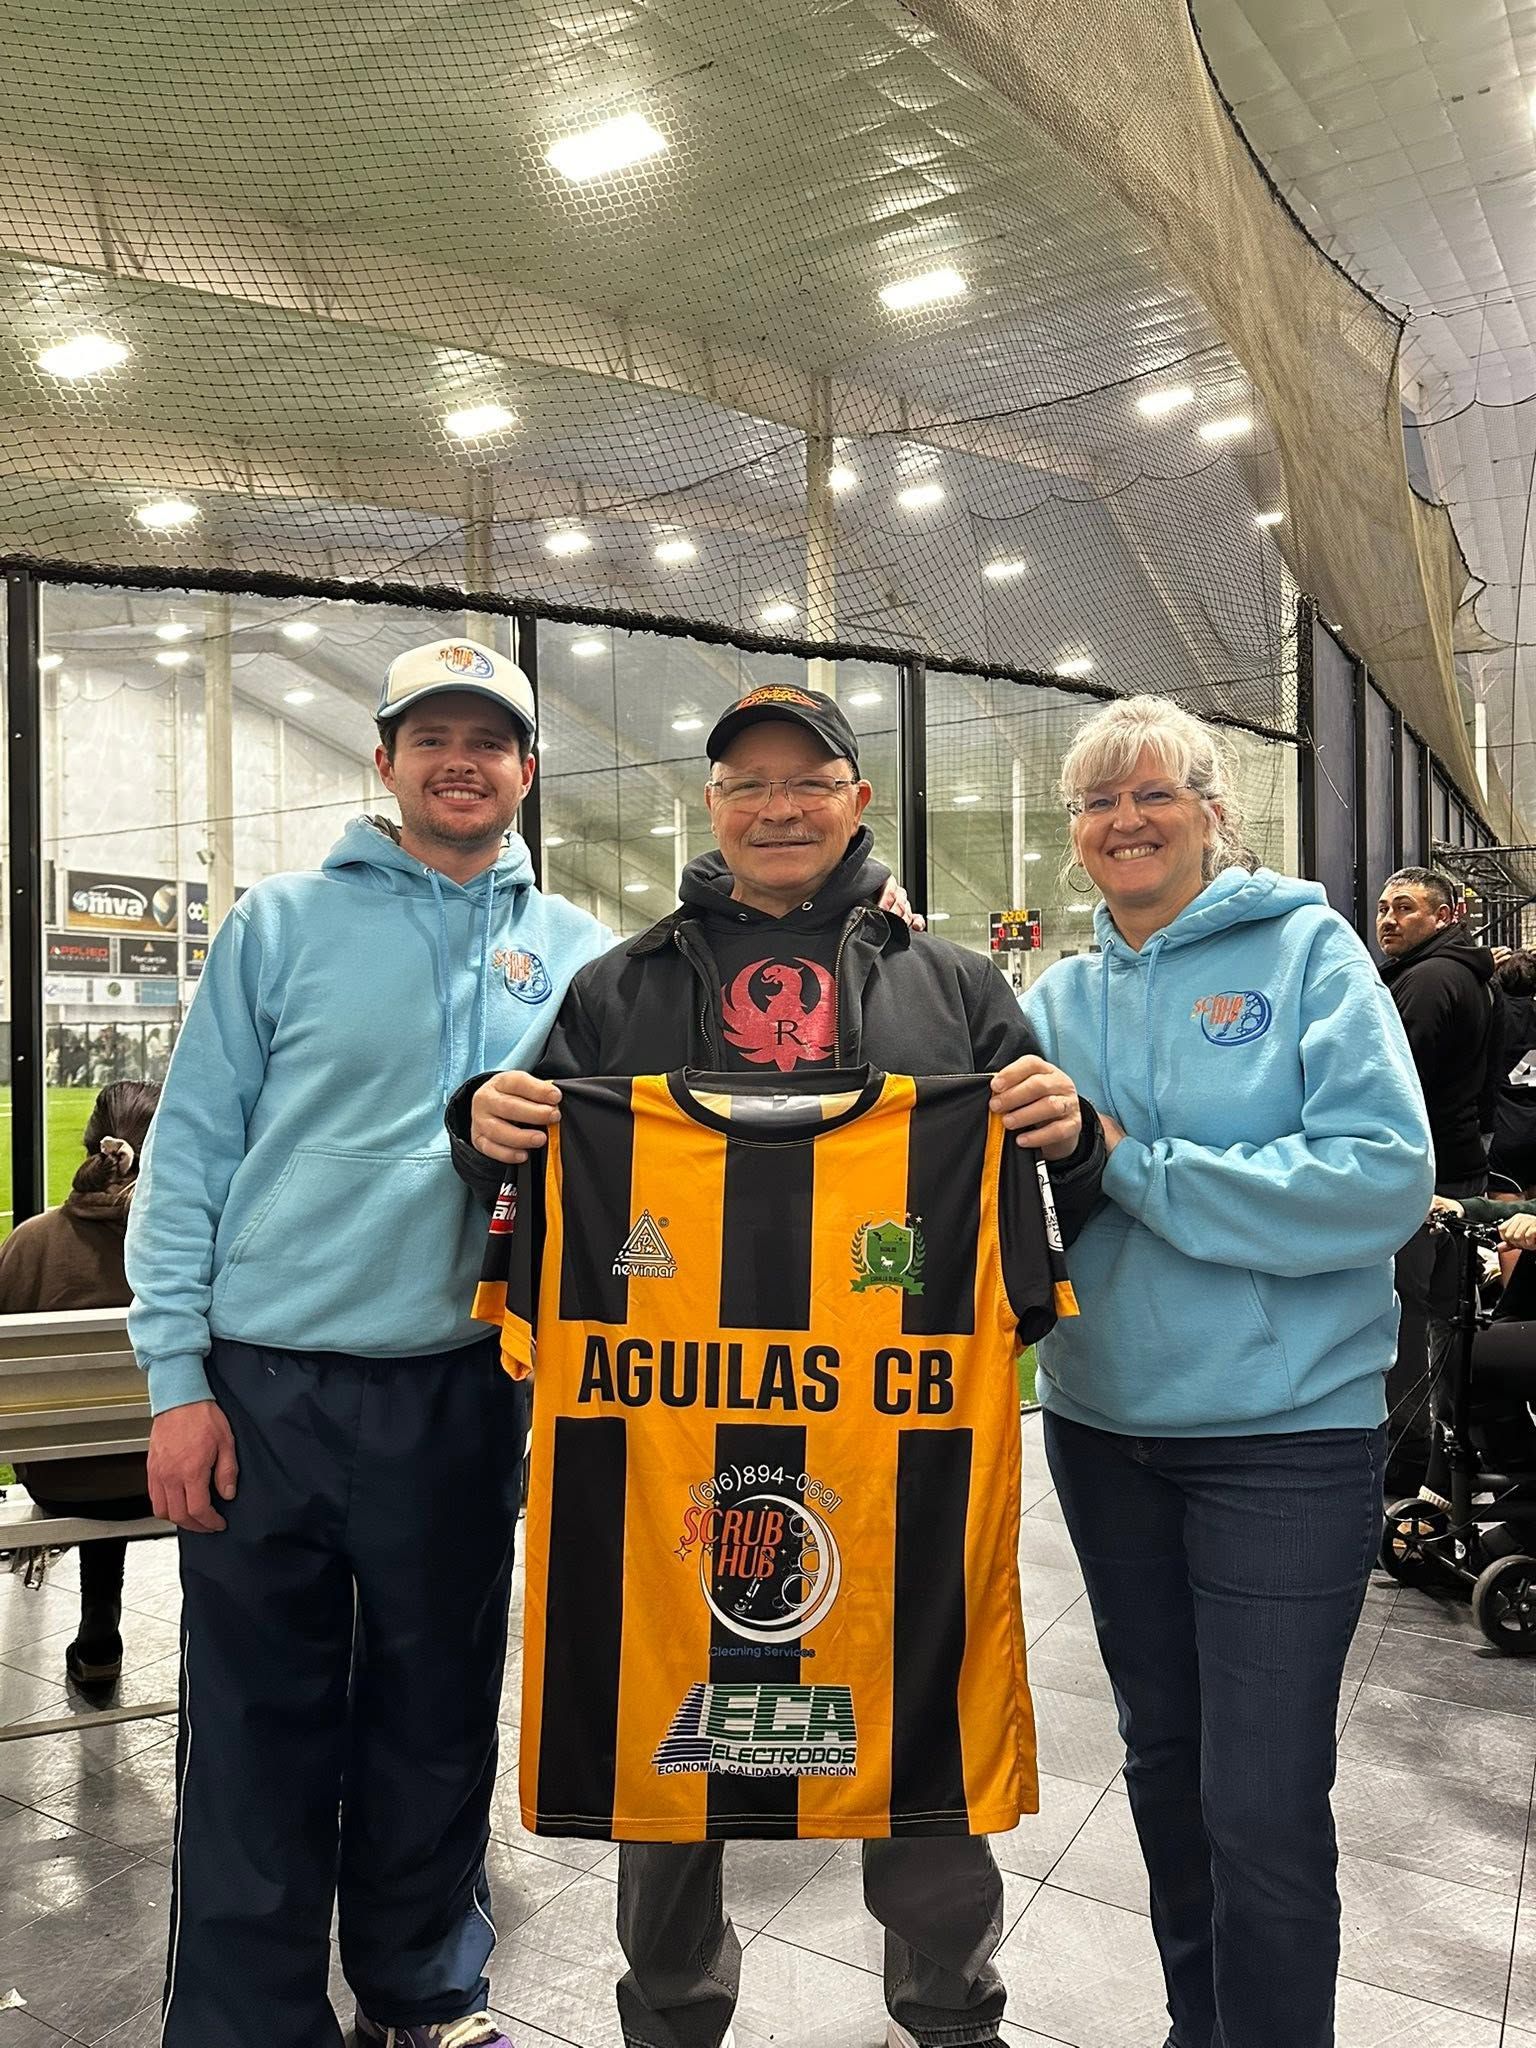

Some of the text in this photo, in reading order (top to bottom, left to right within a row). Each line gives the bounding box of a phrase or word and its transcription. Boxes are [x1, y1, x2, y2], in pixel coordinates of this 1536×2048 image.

[88, 896, 143, 917] mva
[49, 945, 108, 957] APPLIED
[1014, 976, 1020, 987] 2
[774, 1019, 808, 1046] R
[612, 1263, 678, 1279] nevimar
[577, 1335, 954, 1415] AGUILAS CB
[689, 1464, 843, 1514] (616)894-0691
[680, 1506, 784, 1547] SCRUB
[717, 1545, 776, 1579] HUB
[708, 1646, 817, 1659] Cleaning Services
[706, 1684, 857, 1742] ECA
[712, 1743, 857, 1765] ELECTRODOS
[658, 1760, 857, 1777] ECONOMÍA, CALIDAD Y ATENCIÓN
